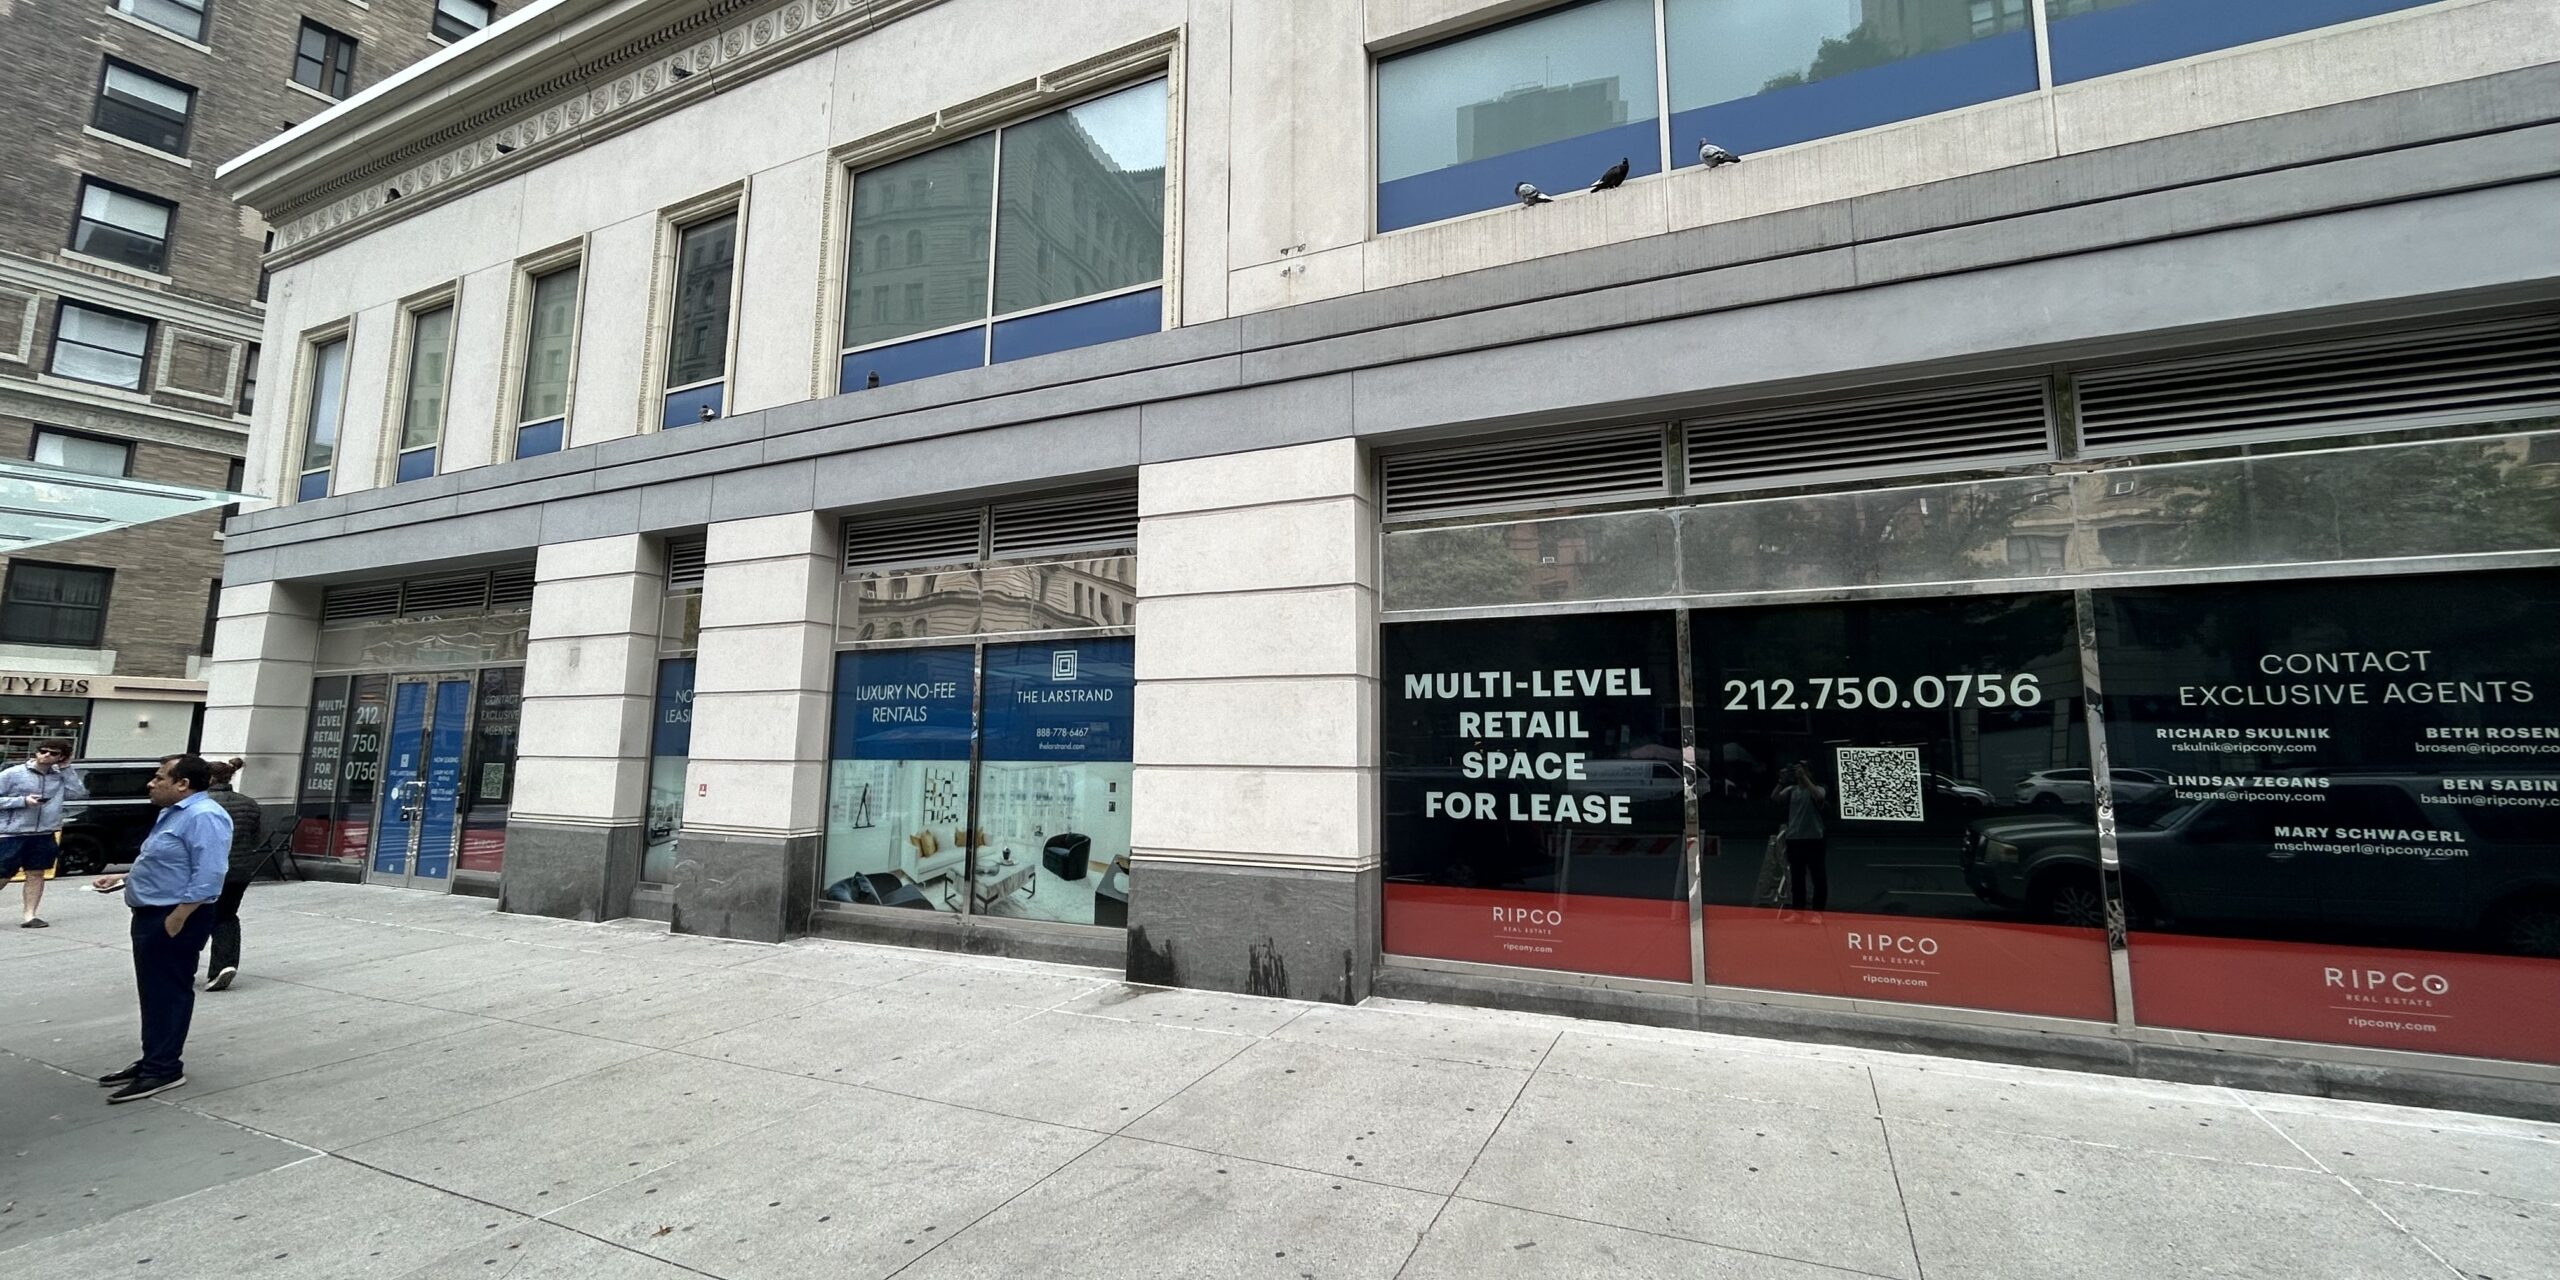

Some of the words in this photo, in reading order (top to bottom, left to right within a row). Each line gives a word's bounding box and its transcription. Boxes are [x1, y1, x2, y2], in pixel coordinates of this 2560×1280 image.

[2259, 650, 2431, 675] CONTACT
[0, 676, 89, 694] TYLES
[1404, 667, 1651, 699] MULTI-LEVEL
[675, 689, 693, 703] NO
[856, 684, 903, 701] LUXURY
[906, 682, 956, 700] NO-FEE
[1017, 690, 1038, 703] THE
[1042, 688, 1113, 703] LARSTRAND
[1723, 673, 2042, 710] 212.750.0756
[2178, 683, 2369, 706] EXCLUSIVE
[2383, 681, 2534, 703] AGENTS
[484, 694, 520, 705] CONTACT
[355, 706, 381, 725] 212.
[665, 709, 691, 723] LEASI
[872, 706, 927, 722] RENTALS
[317, 716, 341, 727] LEVEL
[1459, 711, 1589, 738] RETAIL
[313, 731, 341, 742] RETAIL
[483, 725, 513, 735] AGENTS
[1036, 727, 1089, 737] 888-778-6467
[2156, 728, 2240, 739] RICHARD
[2245, 728, 2331, 739] SKULNIK
[2425, 727, 2479, 739] BETH
[2486, 727, 2560, 739] ROSEN
[352, 734, 378, 753] 750.
[2172, 742, 2316, 753] rskulnik@ripcony.com
[2415, 742, 2560, 754] brosen@ripcony.co
[312, 747, 339, 758] SPACE
[314, 762, 332, 774] FOR
[344, 761, 377, 780] 0756
[1462, 751, 1587, 780] SPACE
[307, 778, 333, 790] LEASE
[2168, 775, 2246, 787] LINDSAY
[2252, 776, 2330, 788] ZEGANS
[2442, 779, 2484, 790] BEN
[2490, 779, 2558, 791] SABIN
[2175, 789, 2325, 802] lzegans@ripcony.com
[2420, 793, 2560, 808] bsabin@ripcony.c
[1426, 791, 1497, 820] FOR
[1509, 793, 1632, 824] LEASE
[2274, 826, 2329, 838] MARY
[2335, 828, 2466, 842] SCHWAGERL
[2274, 841, 2469, 857] mschwagerl@ripcony.com
[1493, 906, 1562, 925] RIPCO
[1503, 942, 1553, 953] ripcony.com
[1847, 932, 1938, 955] RIPCO
[1862, 955, 1887, 963] REAL
[1890, 957, 1926, 966] ESTATE
[1862, 973, 1928, 987] ripcony.com
[2324, 967, 2449, 995] RIPCO
[2345, 994, 2378, 1003] REAL
[2384, 997, 2433, 1007] ESTATE
[2348, 1016, 2437, 1032] ripcony.com
